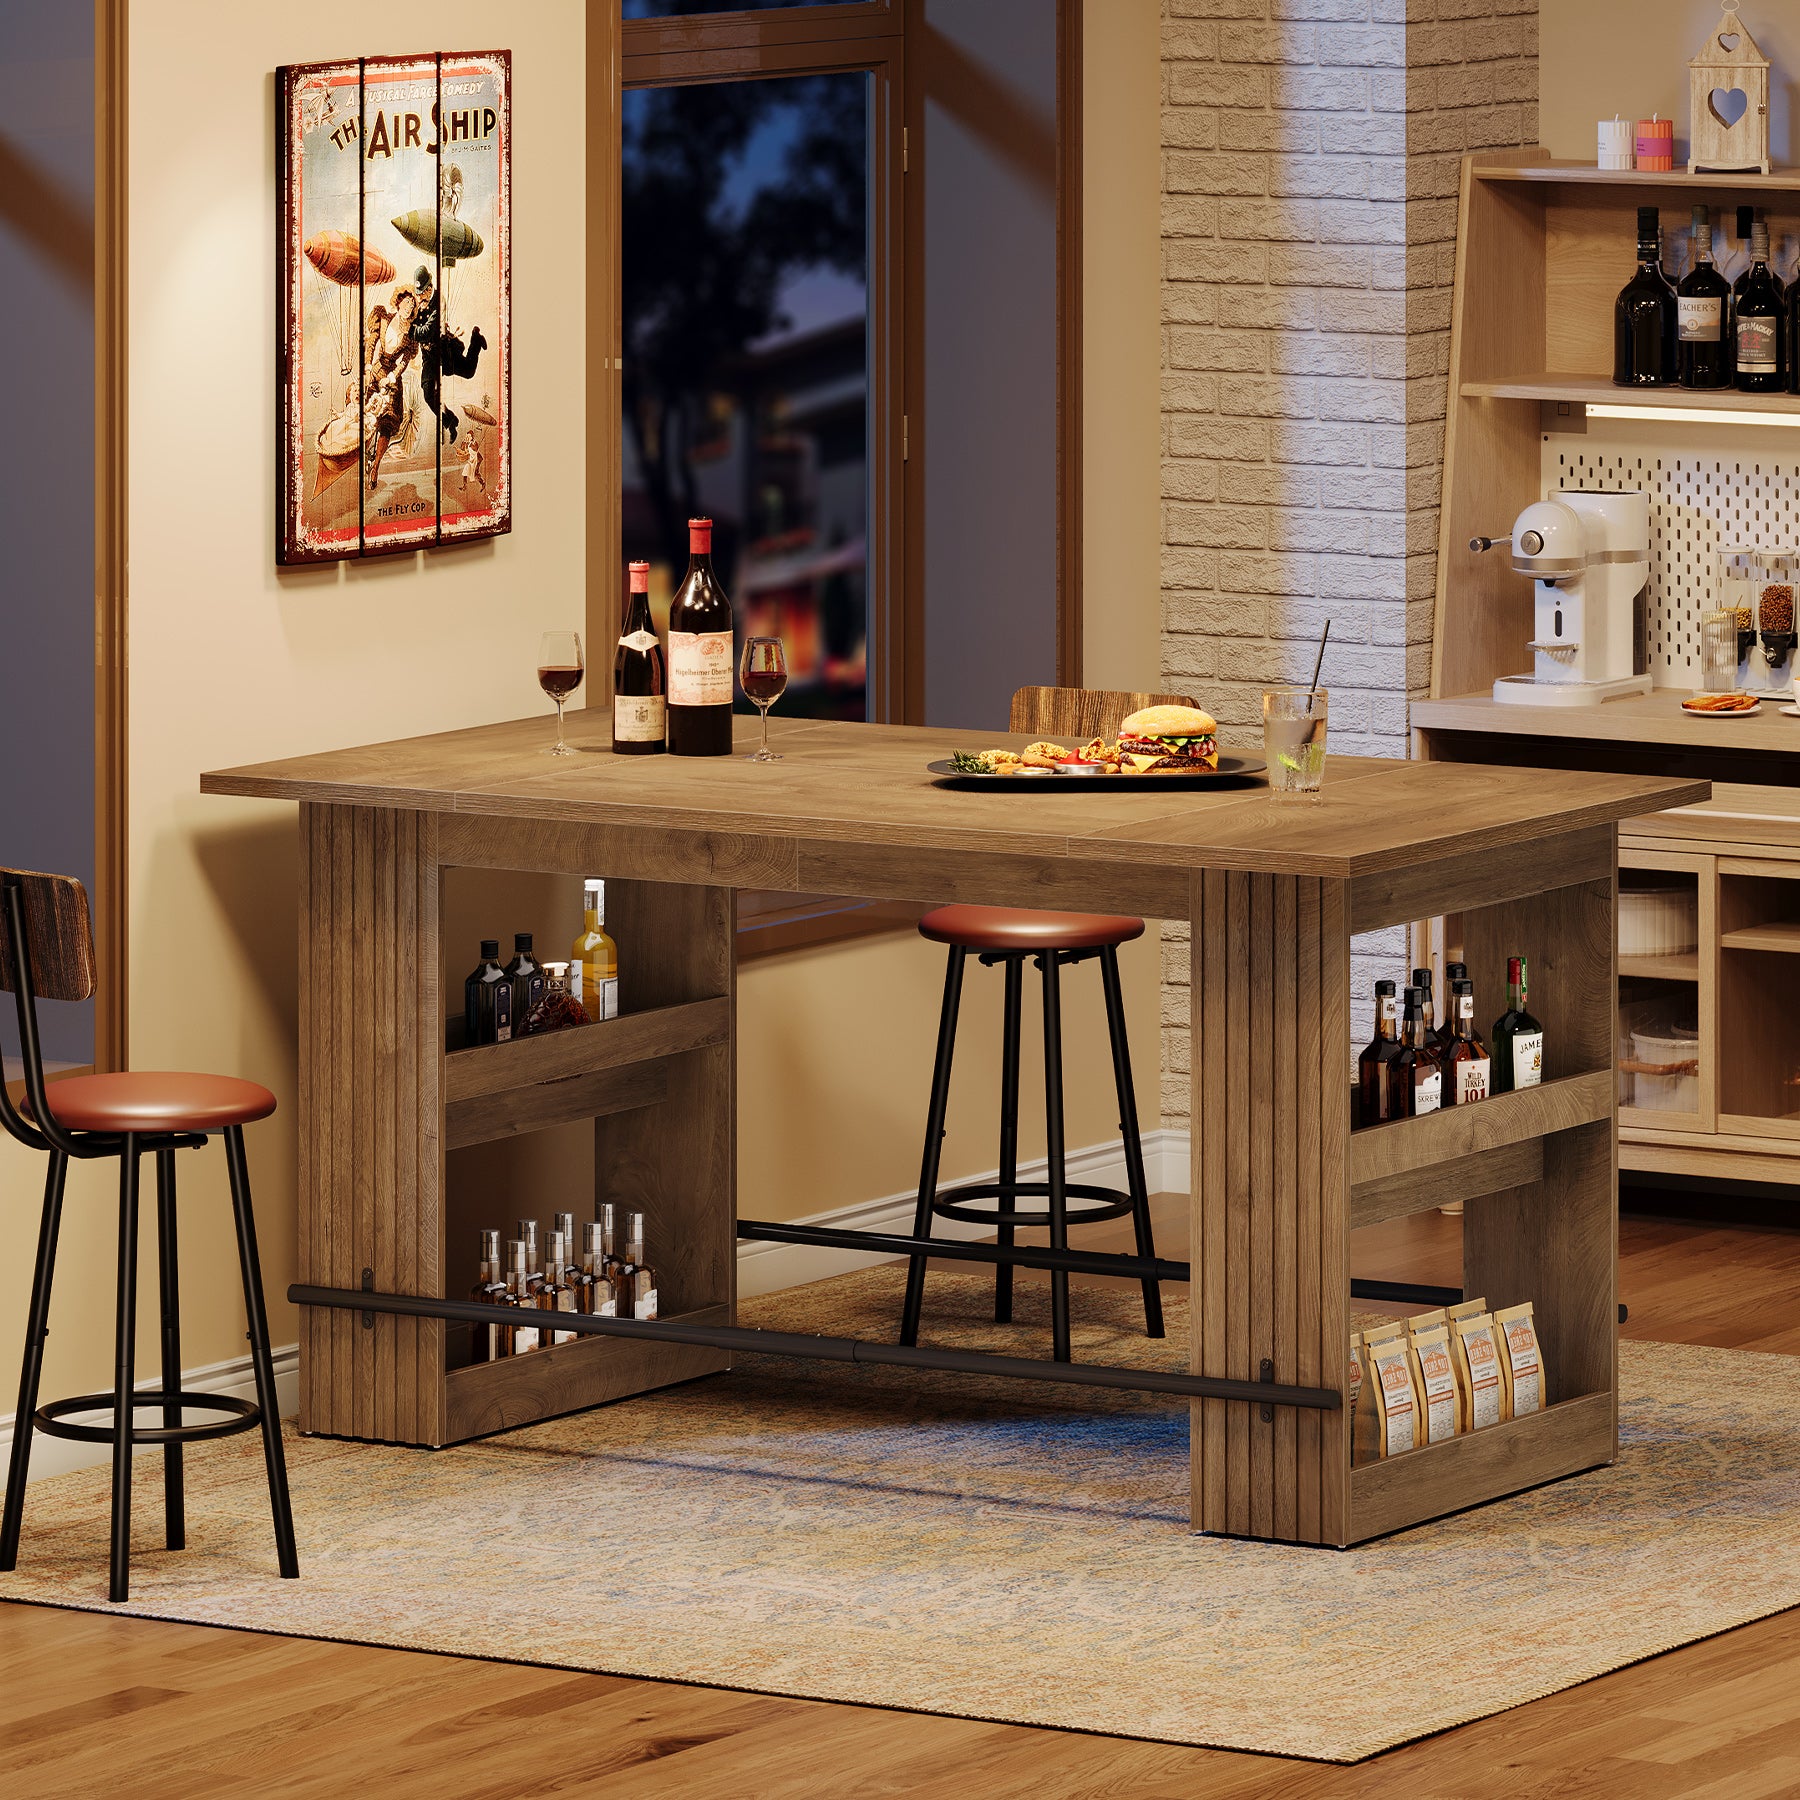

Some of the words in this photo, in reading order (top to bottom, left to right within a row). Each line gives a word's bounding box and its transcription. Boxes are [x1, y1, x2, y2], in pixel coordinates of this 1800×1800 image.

[346, 87, 355, 107] A
[442, 81, 484, 98] COMEDY
[365, 107, 422, 162] AIR
[425, 102, 497, 156] SHIP
[1679, 301, 1718, 312] EACHER'S
[378, 507, 393, 517] THE
[395, 504, 409, 515] FLY
[411, 502, 426, 513] COP
[1519, 1039, 1543, 1055] JAME
[1467, 1071, 1482, 1080] WILD
[1464, 1078, 1486, 1089] TURKEY
[1417, 1093, 1440, 1103] SKREW
[1464, 1087, 1486, 1103] 101
